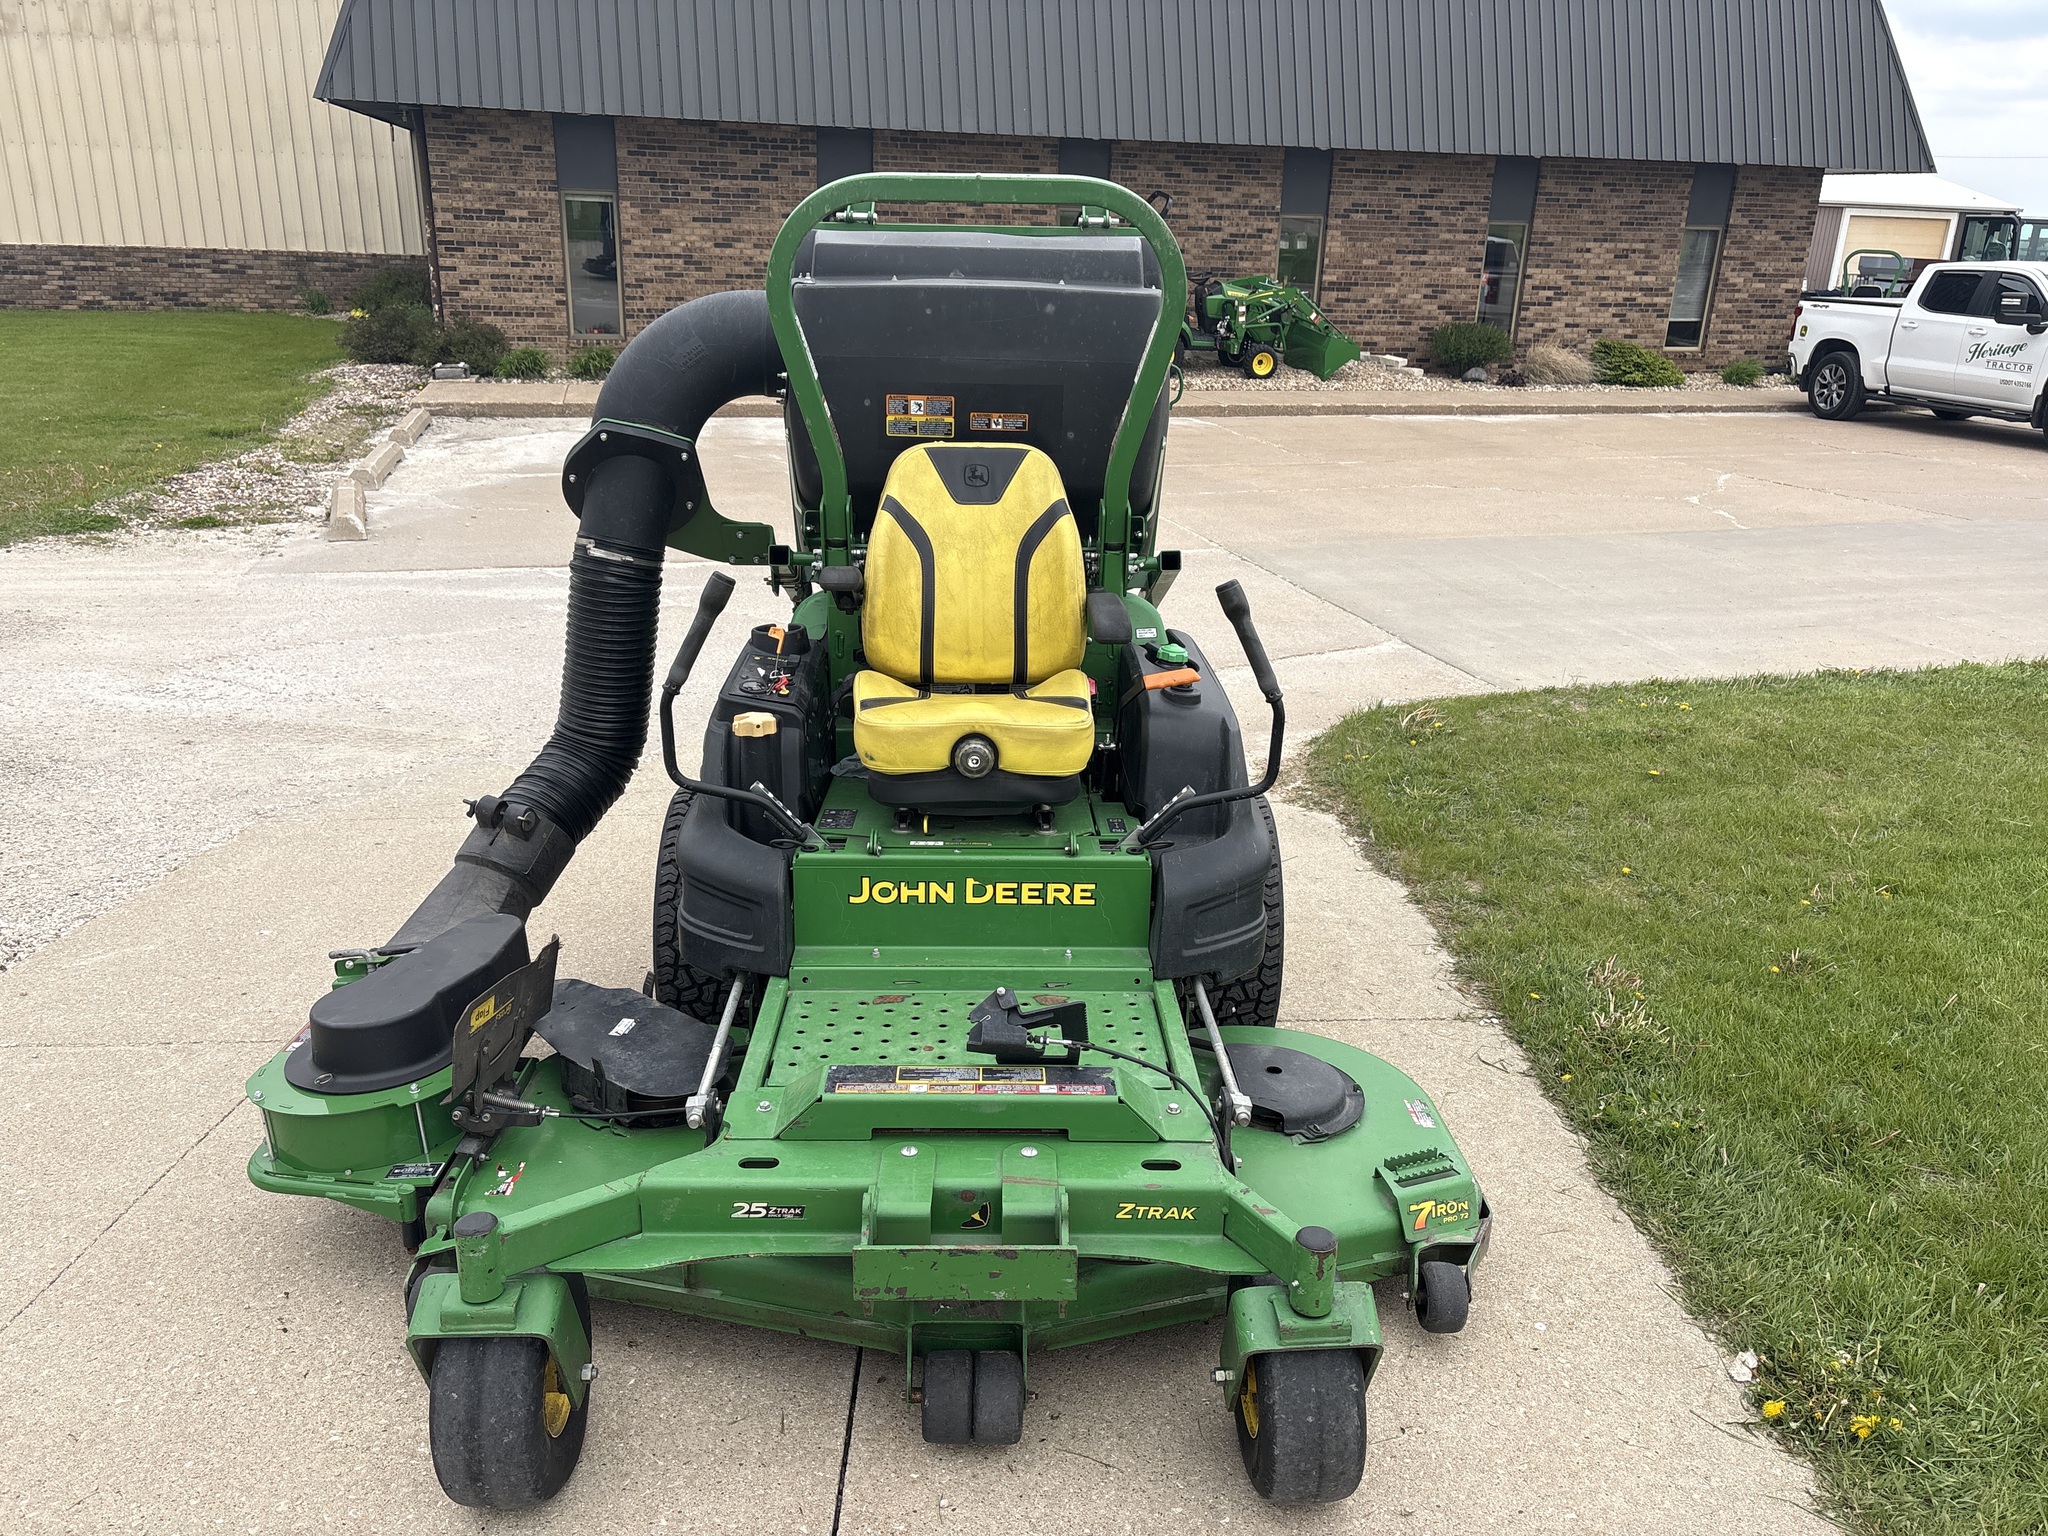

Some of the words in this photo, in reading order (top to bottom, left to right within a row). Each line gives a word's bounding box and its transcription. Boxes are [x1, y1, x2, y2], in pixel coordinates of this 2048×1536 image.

[1965, 340, 2028, 363] Heritage
[1986, 361, 2032, 372] TRACTOR
[848, 876, 955, 904] JOHN
[964, 877, 1097, 906] DEERE
[475, 1004, 490, 1021] Flap
[731, 1203, 767, 1218] 25
[1115, 1203, 1198, 1220] ZTRAK
[1443, 1215, 1458, 1224] PRO
